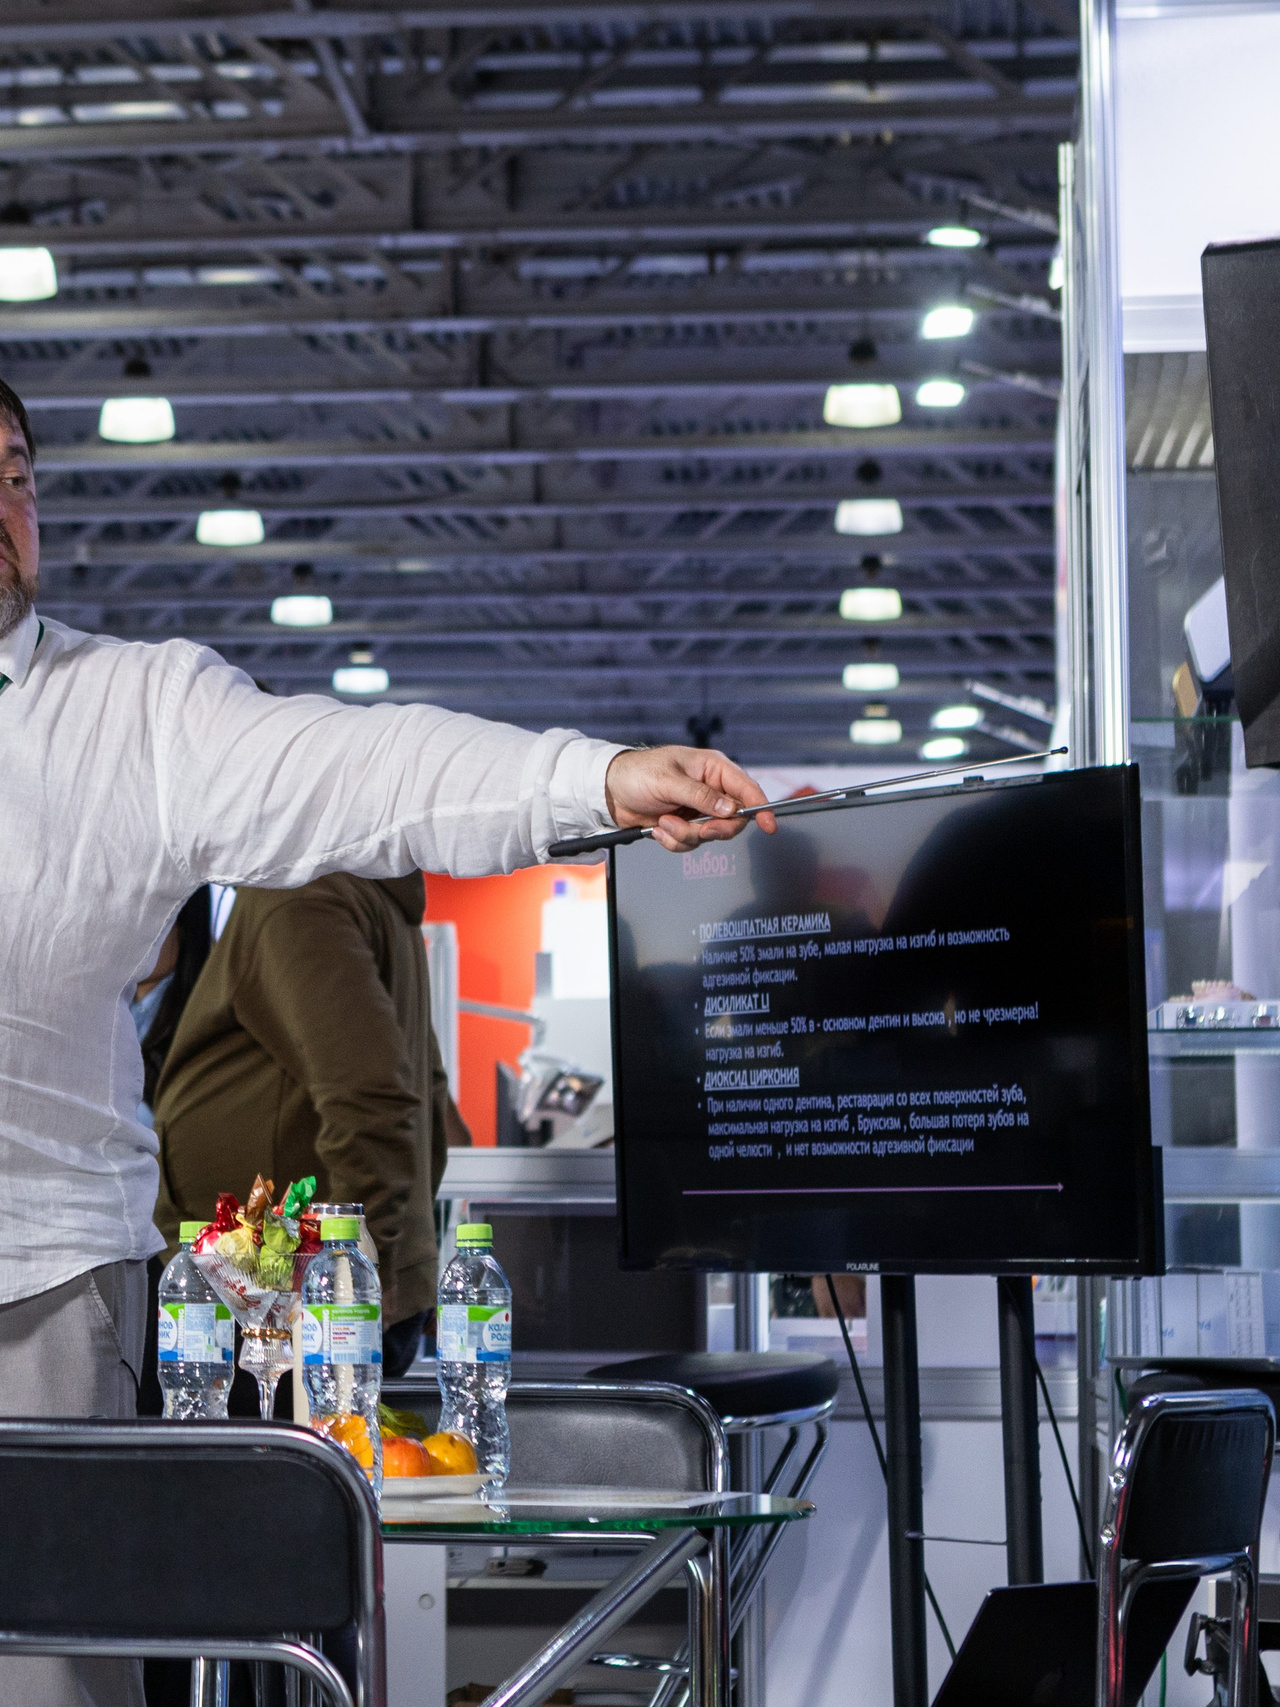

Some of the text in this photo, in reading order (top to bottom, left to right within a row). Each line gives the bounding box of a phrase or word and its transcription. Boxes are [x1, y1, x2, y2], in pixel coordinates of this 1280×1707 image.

[682, 851, 728, 877] Выбор
[699, 912, 831, 940] ПОЛЕВОШПАТНАЯ КЕРАМИКА
[702, 927, 1011, 966] Наличие 50% эмали на зубе, малая нагрузка на изгиб и возможность
[702, 967, 798, 990] адгезивной фиксации.
[704, 993, 759, 1014] ДИСИЛИКАТ
[704, 1022, 725, 1039] Если
[726, 1023, 753, 1038] эмали
[755, 1020, 788, 1036] меньше
[790, 1016, 807, 1033] 50%
[809, 1019, 815, 1032] в
[823, 1016, 866, 1032] основном
[868, 1013, 901, 1032] дентин
[903, 1013, 910, 1026] и
[912, 1010, 946, 1027] высока
[954, 1009, 967, 1024] но
[969, 1009, 981, 1023] не
[982, 1001, 1039, 1026] чрезмерна!
[705, 1041, 785, 1064] нагрузка на изгиб.
[704, 1066, 800, 1090] ДИОКСИД ЦИРКОНИЯ
[706, 1083, 1027, 1117] При наличии одного дентина, реставрация со всех поверхностей зуба,
[708, 1120, 768, 1136] максимальная
[770, 1119, 809, 1137] нагрузка
[810, 1119, 822, 1133] на
[823, 1114, 850, 1133] изгиб
[857, 1114, 901, 1135] Бруксизм
[909, 1111, 950, 1130] большая
[952, 1113, 985, 1132] потеря
[987, 1109, 1015, 1131] зубов
[1017, 1112, 1030, 1126] на
[708, 1140, 735, 1161] одной
[736, 1143, 773, 1158] челюсти
[785, 1143, 793, 1156] и
[794, 1143, 809, 1156] нет
[811, 1140, 870, 1156] возможности
[872, 1135, 925, 1157] адгезивной
[927, 1135, 975, 1157] фиксации
[846, 1262, 880, 1271] POLARLINE
